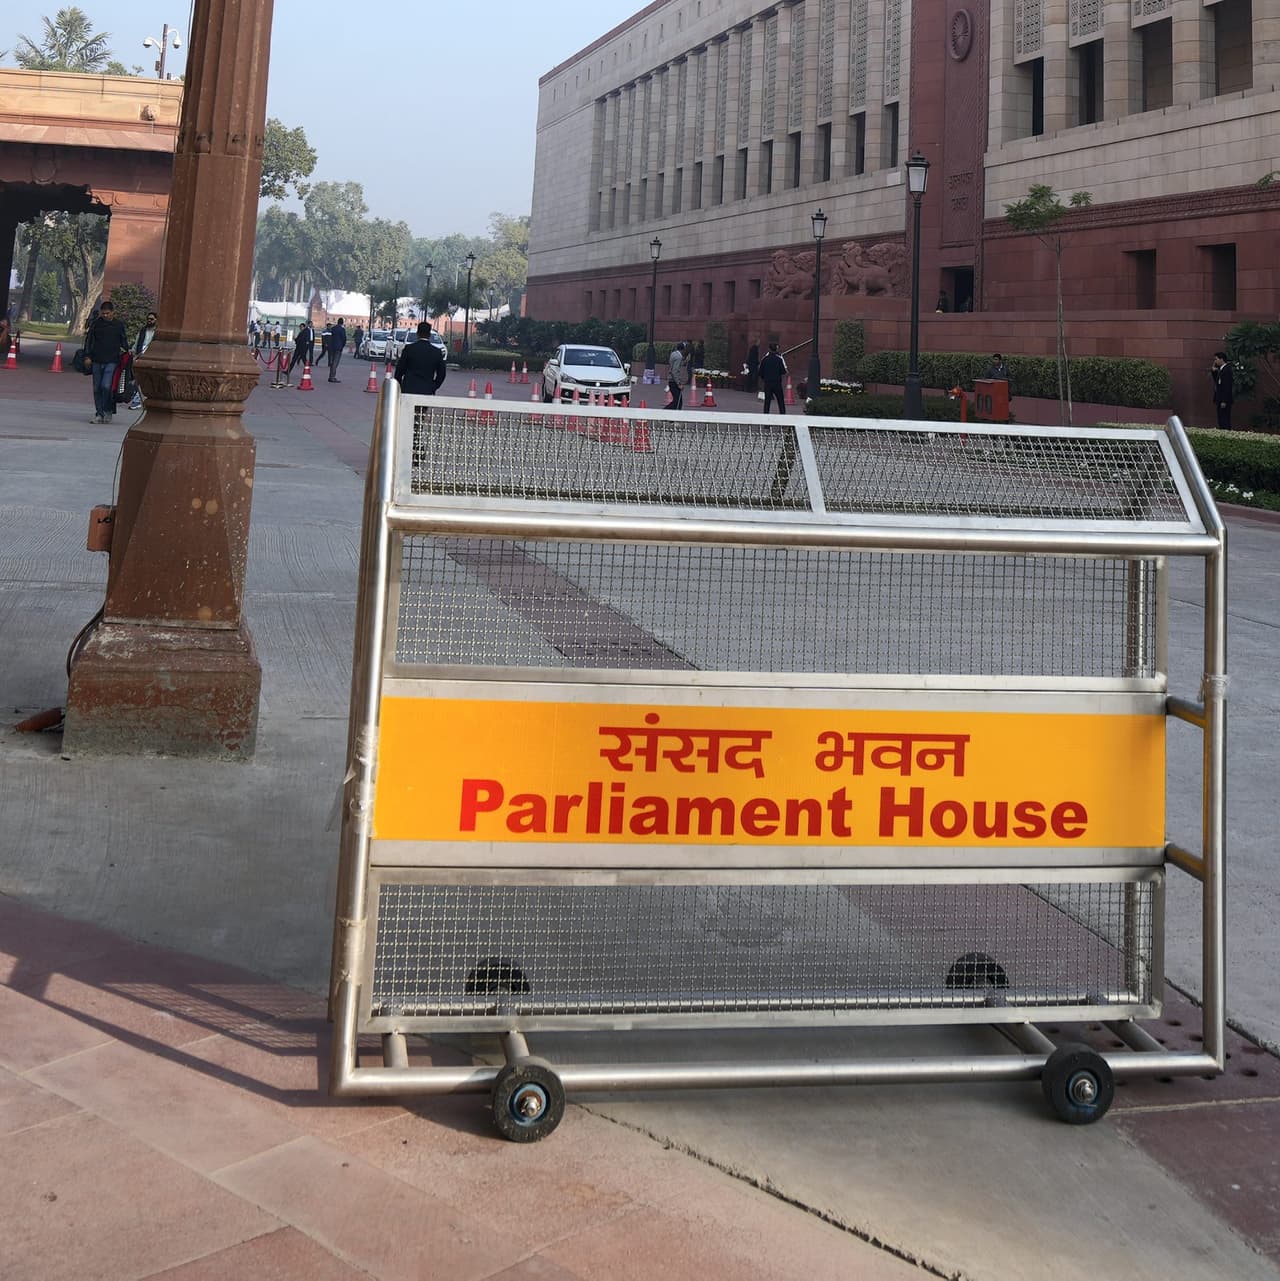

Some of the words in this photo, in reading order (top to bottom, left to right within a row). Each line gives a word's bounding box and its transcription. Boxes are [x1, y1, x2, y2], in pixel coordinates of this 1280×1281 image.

[598, 712, 773, 778] संसद
[814, 730, 971, 777] भवन
[459, 778, 853, 838] Parliament
[878, 786, 1088, 839] House
